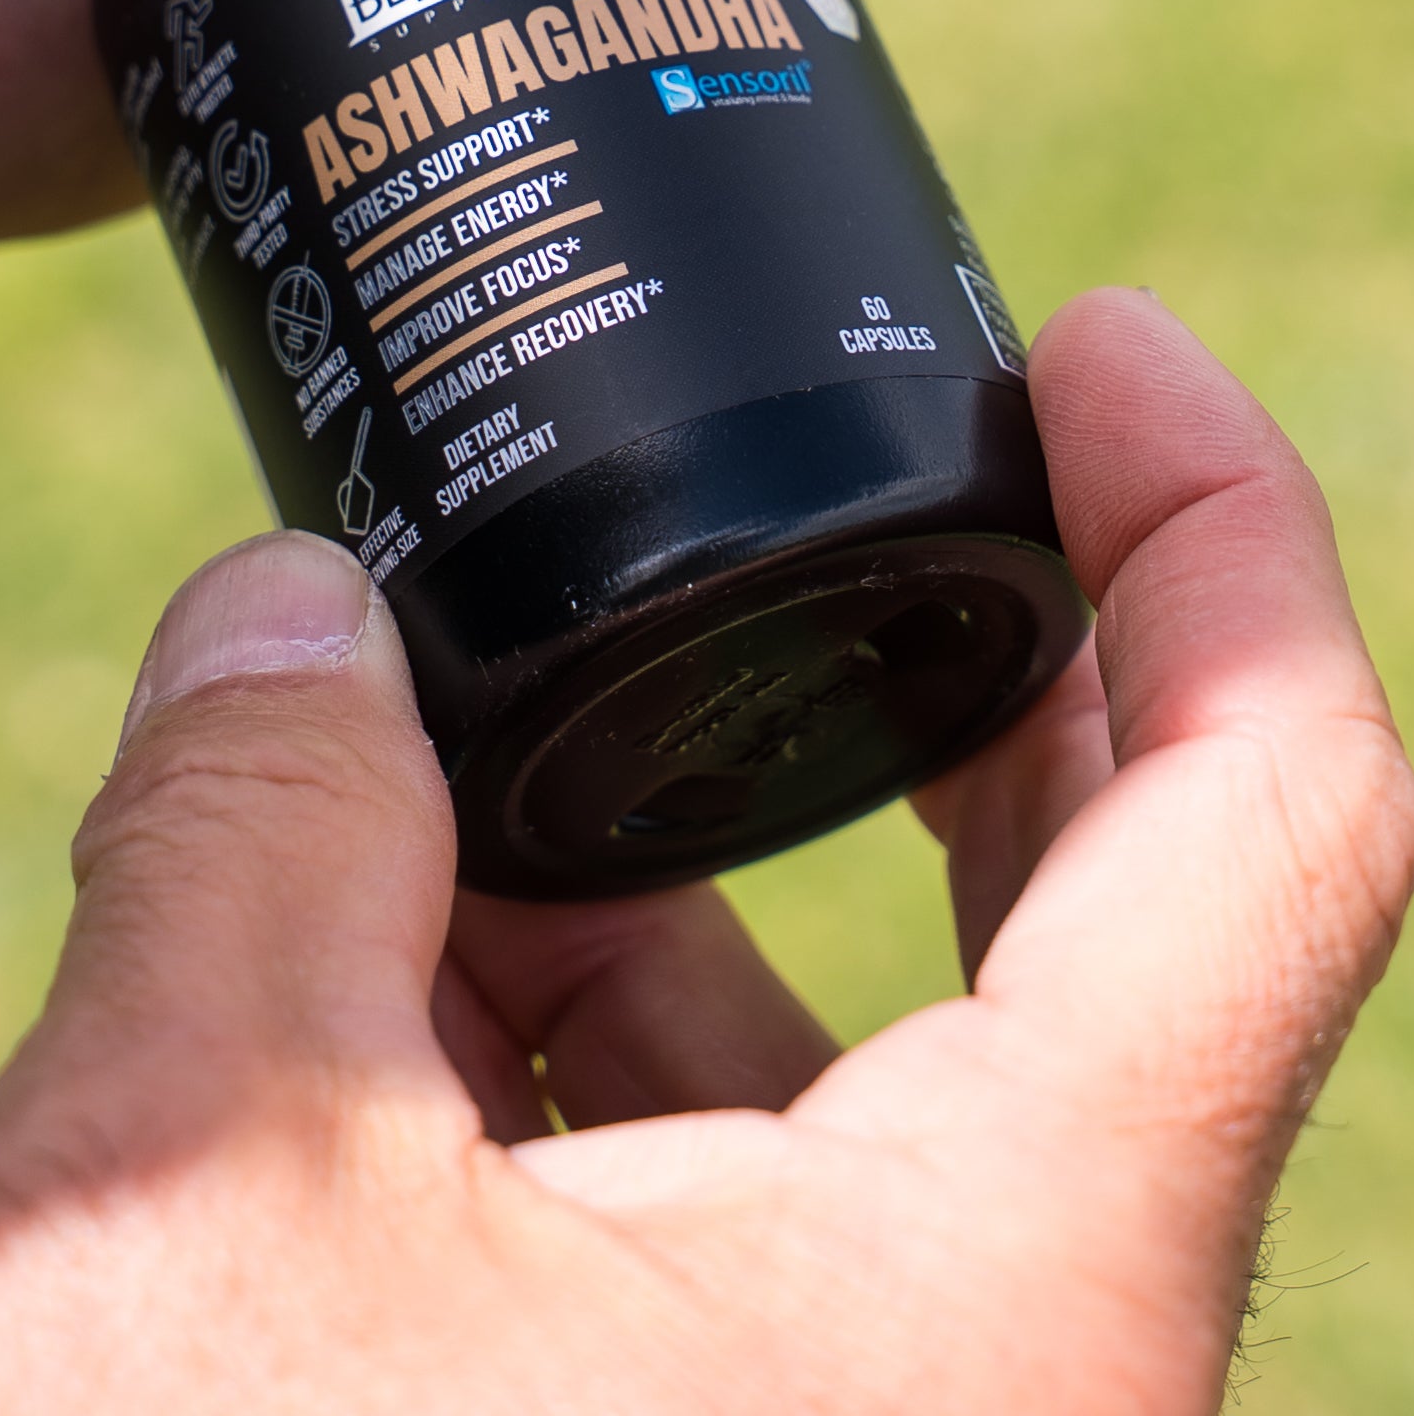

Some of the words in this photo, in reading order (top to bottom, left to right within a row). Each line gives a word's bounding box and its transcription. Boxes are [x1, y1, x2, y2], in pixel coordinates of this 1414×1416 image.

[331, 170, 418, 248] STRESS
[251, 222, 288, 271] TESTED
[353, 224, 454, 311] MANAGE
[377, 287, 484, 373] IMPROVE
[838, 326, 937, 354] CAPSULES
[860, 295, 892, 321] 60
[295, 385, 312, 413] NO
[306, 346, 348, 398] BANNED
[302, 367, 361, 440] SUBSTANCES
[400, 342, 514, 436] ENHANCE
[435, 420, 559, 516] SUPPLEMENT
[443, 402, 521, 471] DIETARY
[358, 505, 406, 566] EFFECTIVE
[368, 545, 400, 586] RVING
[396, 522, 423, 558] SIZE
